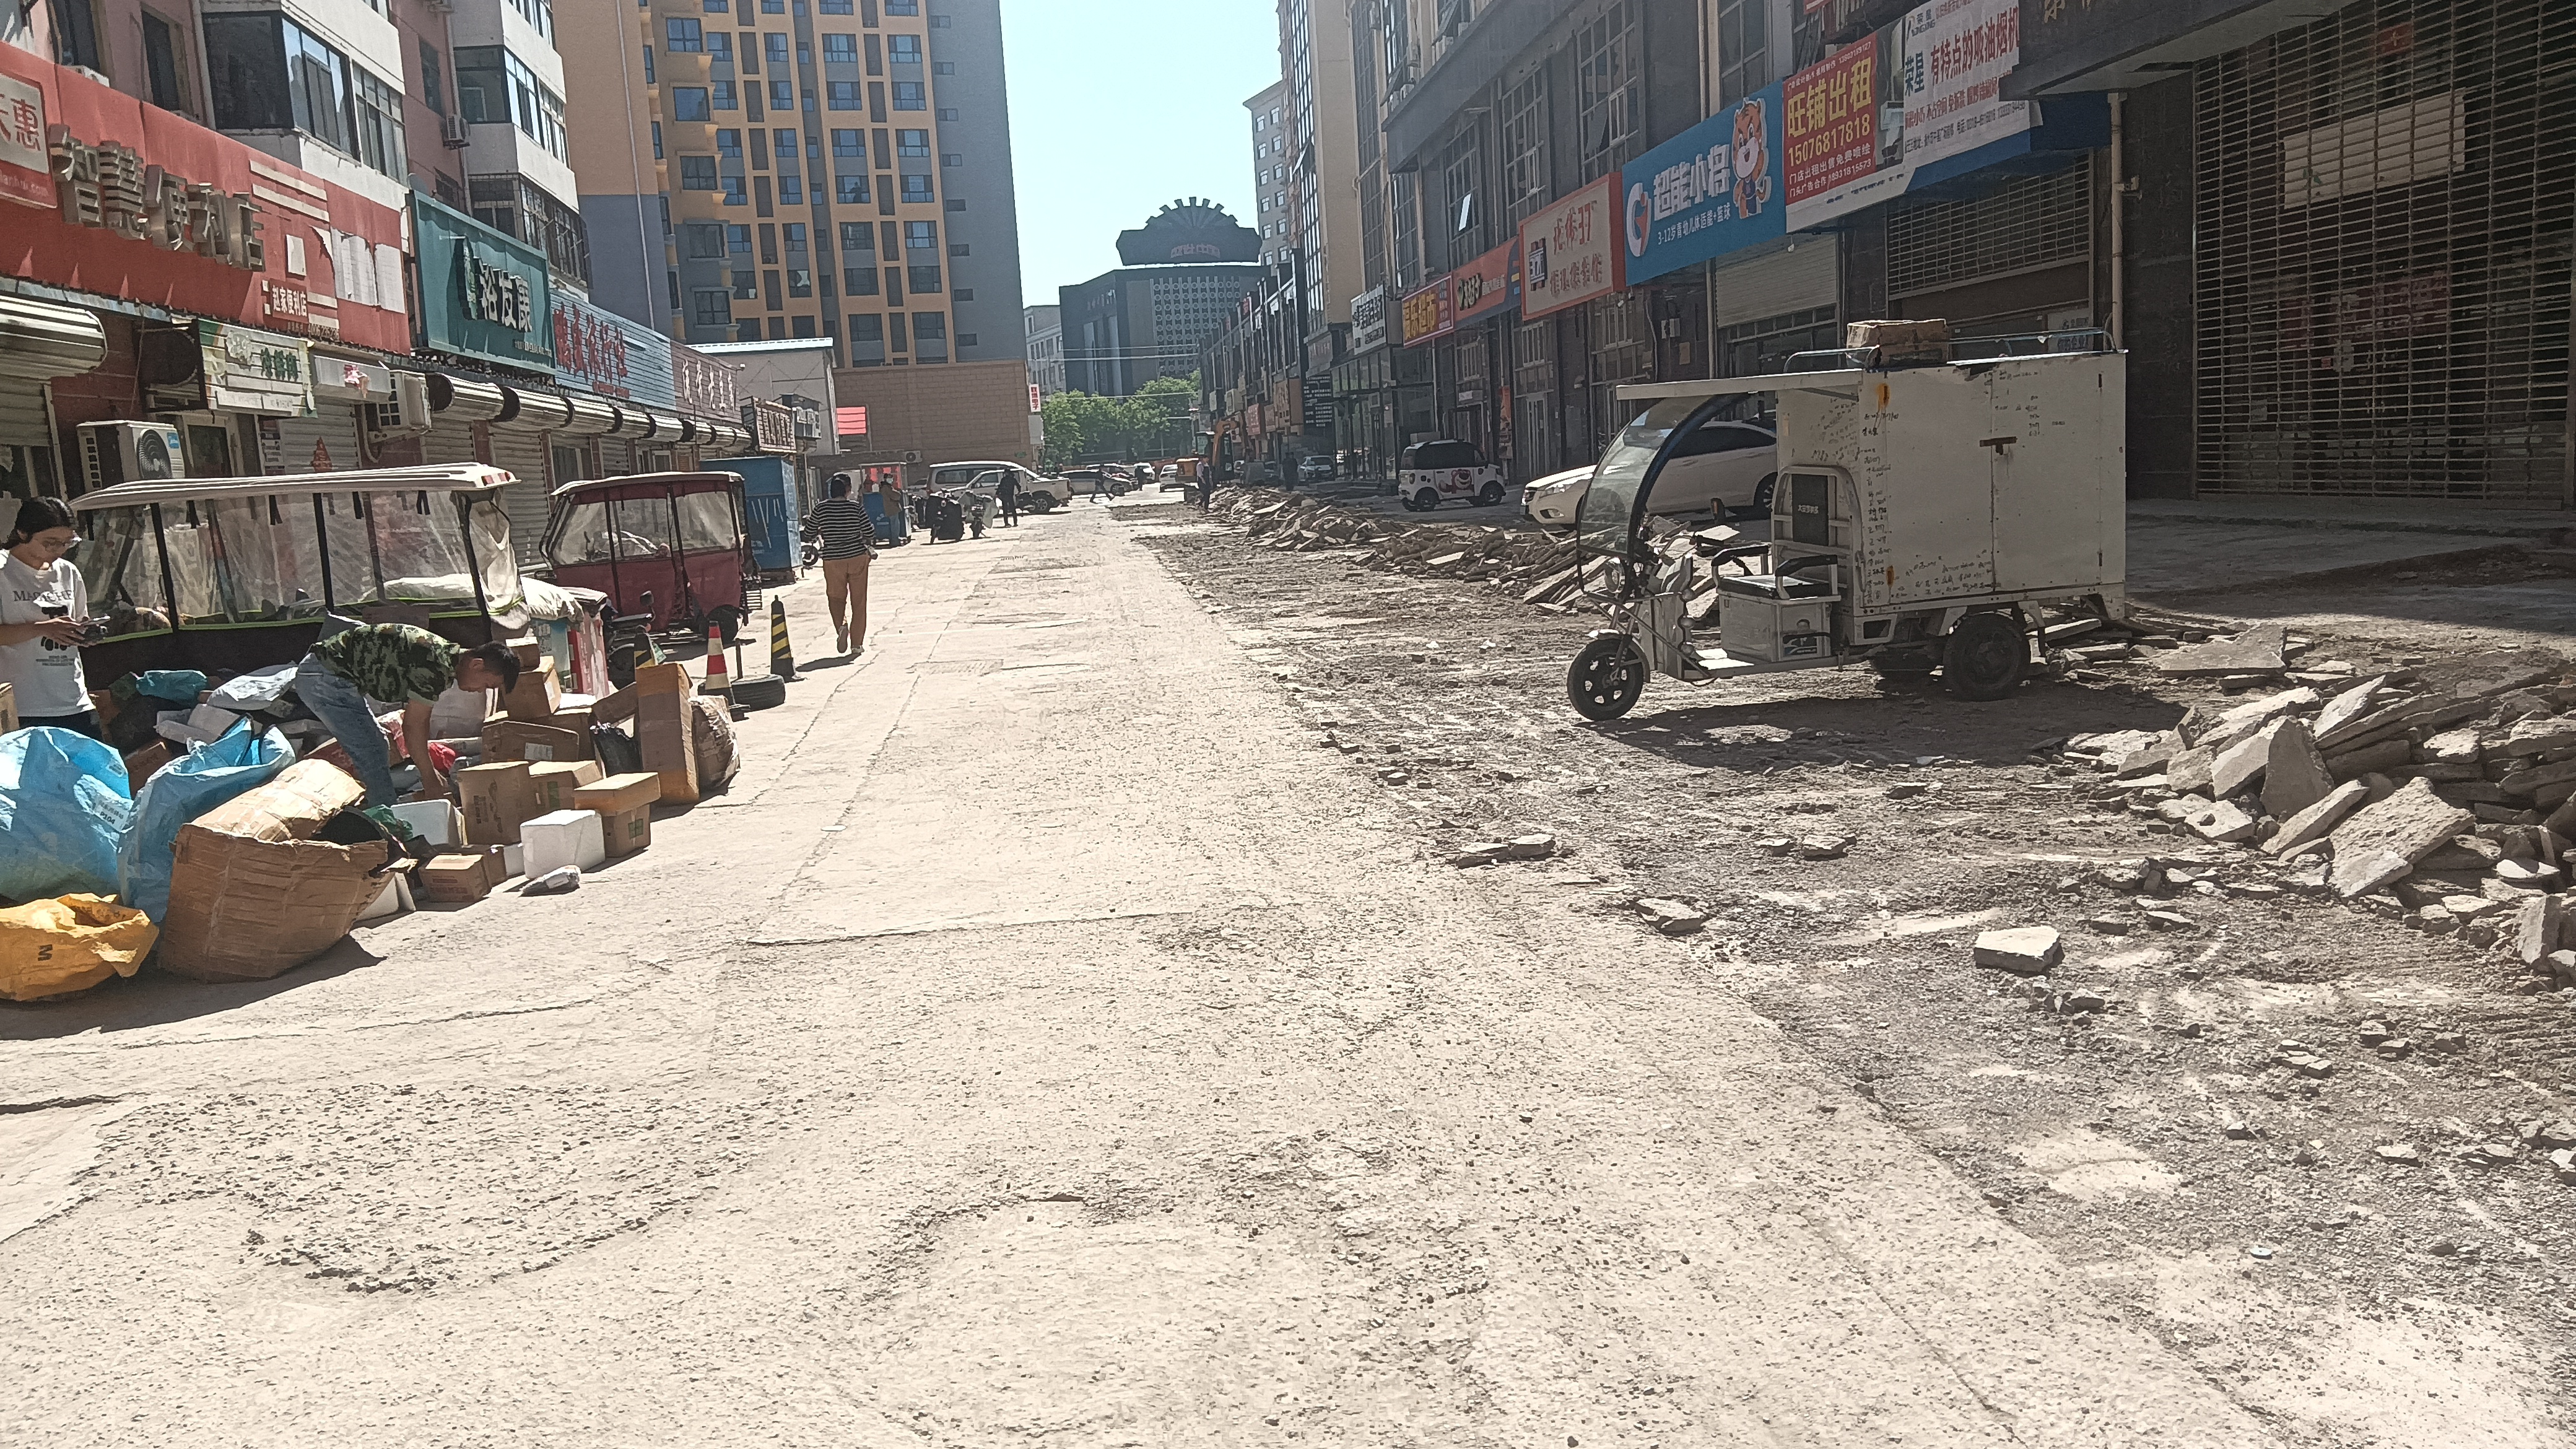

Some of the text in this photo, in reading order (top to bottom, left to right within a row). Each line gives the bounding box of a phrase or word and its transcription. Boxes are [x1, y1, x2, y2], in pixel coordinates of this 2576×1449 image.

[1788, 57, 1871, 137] 旺铺出租
[1905, 51, 1925, 97] 荣星
[1788, 113, 1870, 167] 15076817818
[1790, 143, 1871, 185] 门店出租出售免费喷绘
[48, 124, 264, 271] 智慧便利店
[1654, 144, 1731, 221] 超能小将
